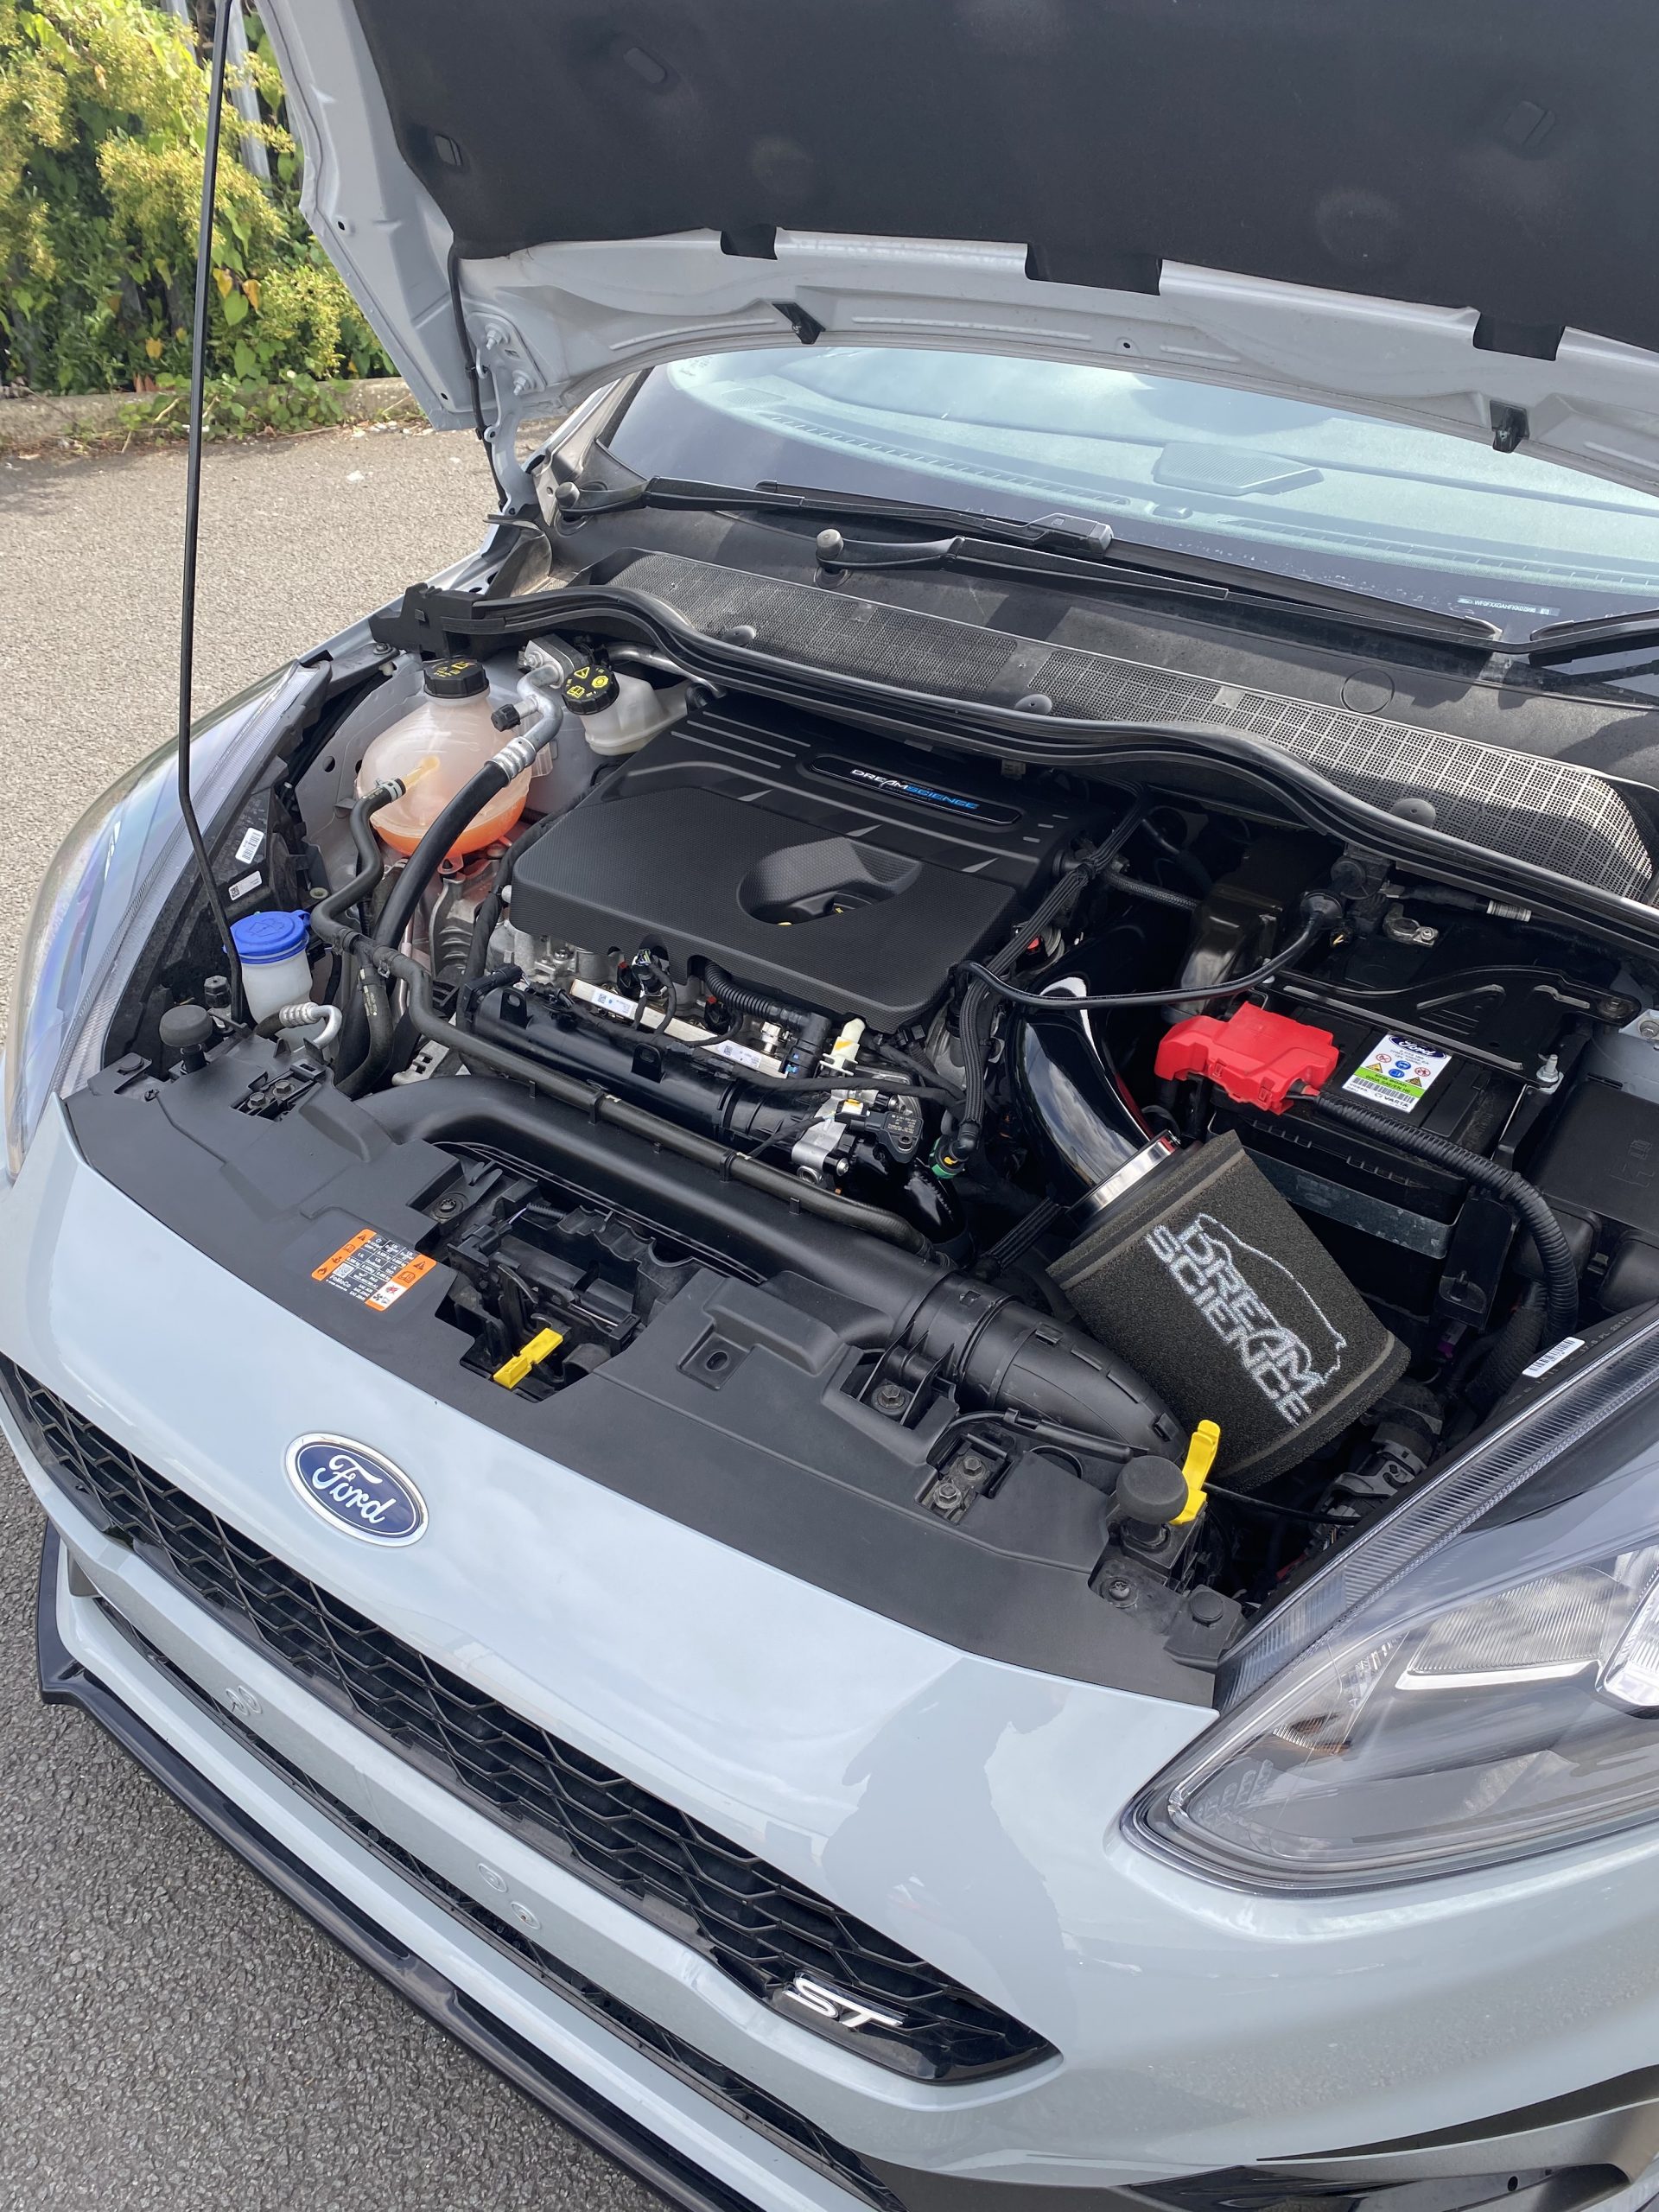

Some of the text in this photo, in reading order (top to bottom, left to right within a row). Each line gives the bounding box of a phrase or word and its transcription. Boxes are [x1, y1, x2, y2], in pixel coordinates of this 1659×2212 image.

[1398, 1040, 1437, 1055] Ford
[1384, 1096, 1409, 1108] VARTA
[1145, 1224, 1313, 1427] SCIENCE
[312, 1454, 397, 1523] Ford
[781, 1977, 904, 2028] ST
